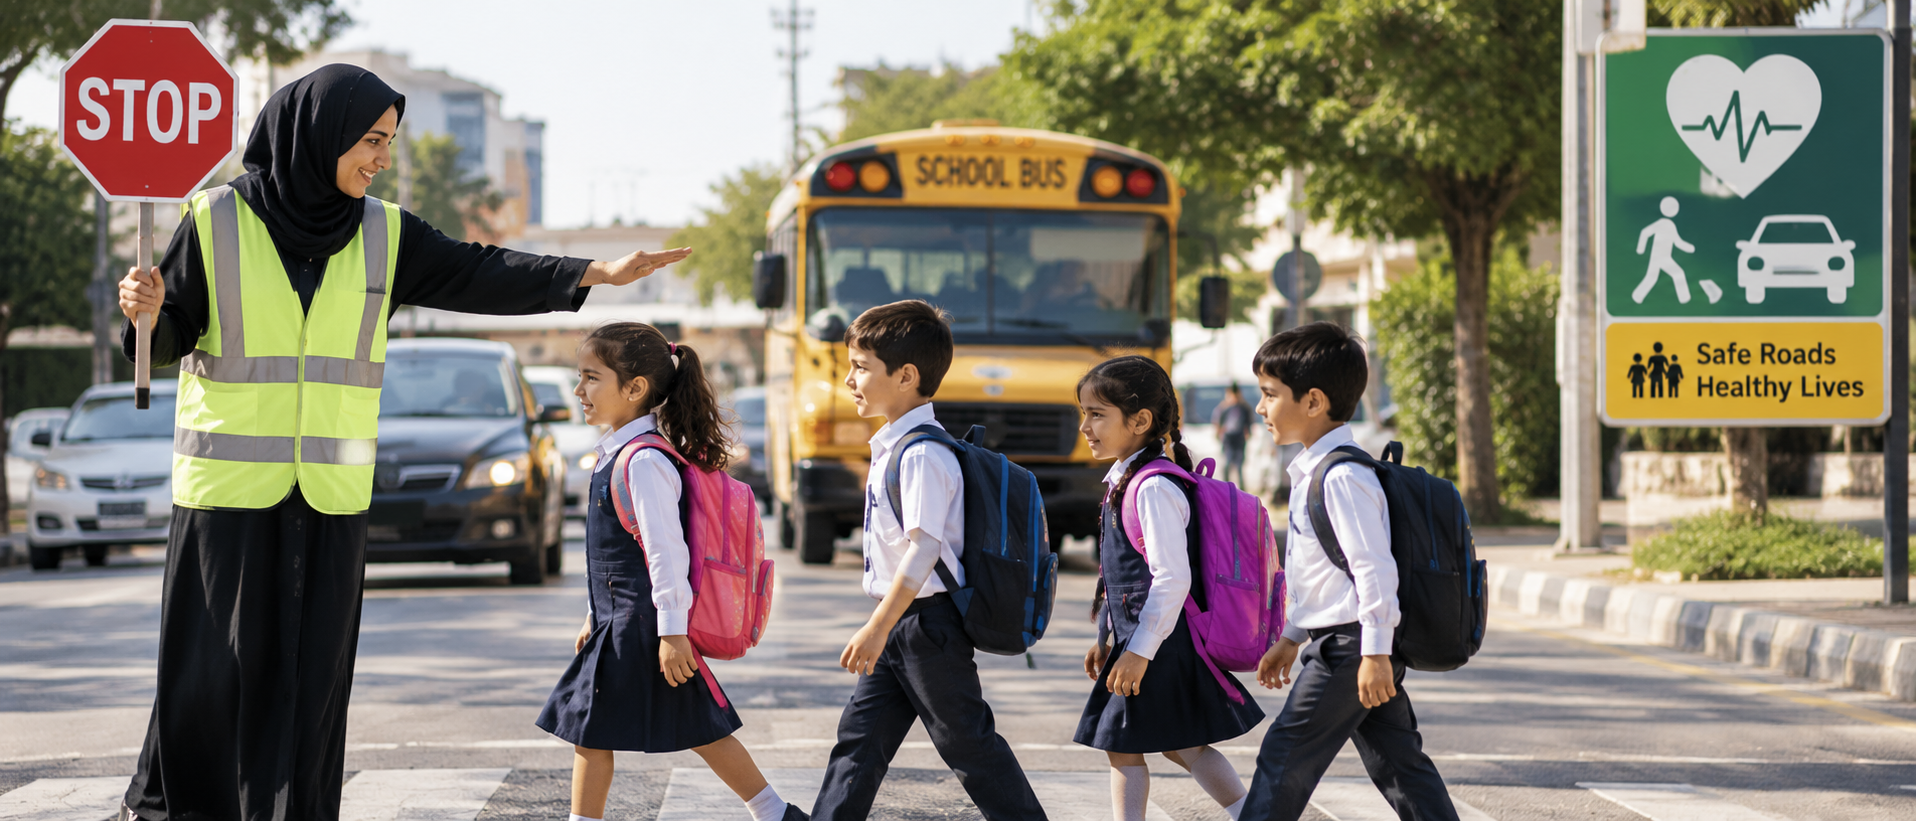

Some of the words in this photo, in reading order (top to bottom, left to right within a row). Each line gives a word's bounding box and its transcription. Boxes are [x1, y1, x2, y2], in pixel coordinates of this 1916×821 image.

[76, 76, 222, 144] STOP
[915, 154, 1013, 188] SCHOOL
[1020, 157, 1067, 189] BUS
[1697, 341, 1752, 365] Safe
[1760, 341, 1836, 365] Roads
[1697, 374, 1792, 403] Healthy
[1801, 374, 1864, 397] Lives
